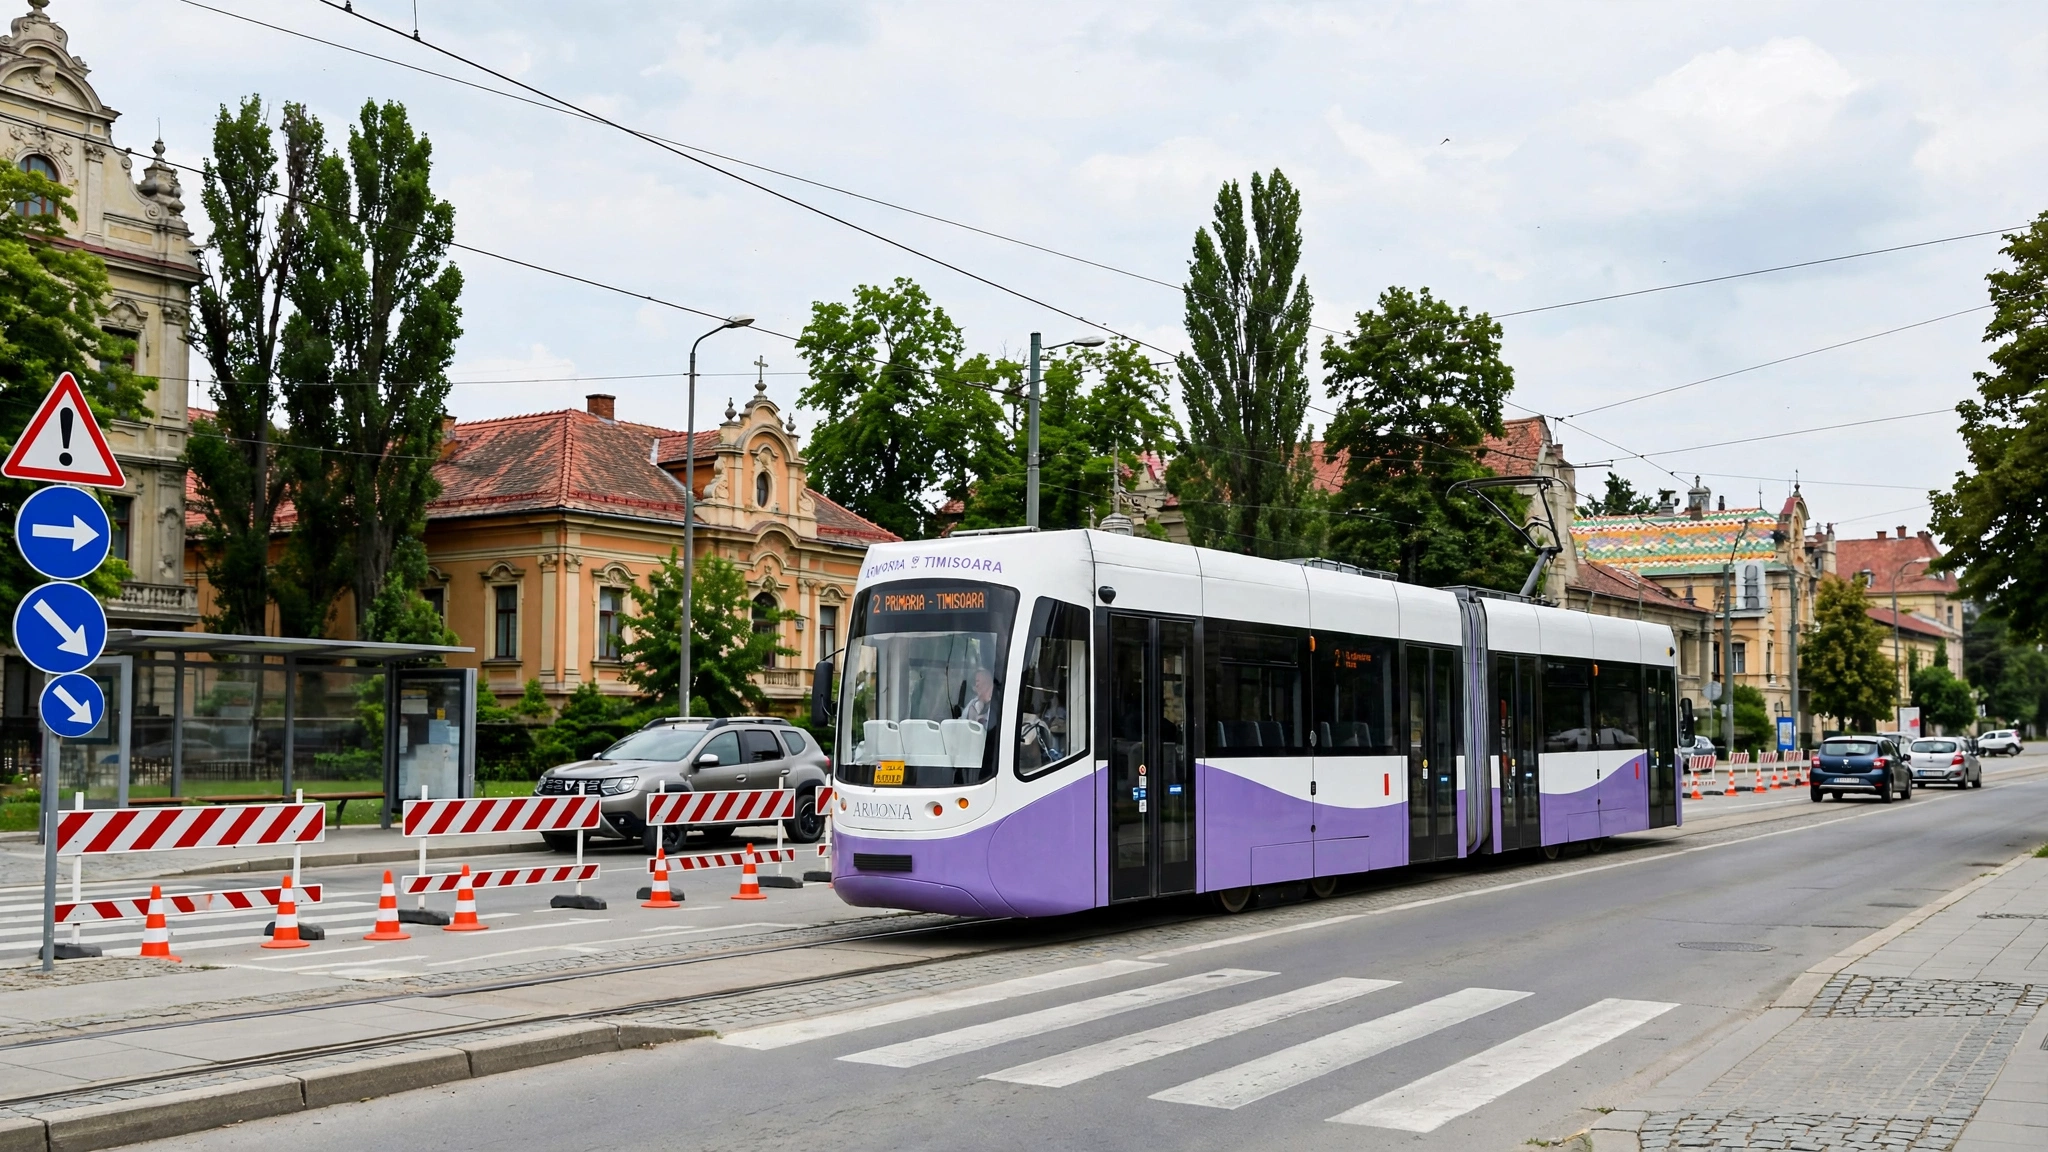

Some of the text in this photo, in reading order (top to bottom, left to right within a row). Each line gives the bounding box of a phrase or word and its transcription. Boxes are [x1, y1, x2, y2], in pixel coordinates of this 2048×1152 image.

[924, 556, 1002, 573] TIMISOARA
[872, 594, 880, 614] 2
[885, 594, 925, 611] PRIMARIA
[936, 592, 985, 610] TIMISOARA
[852, 801, 913, 821] ARMONIA
